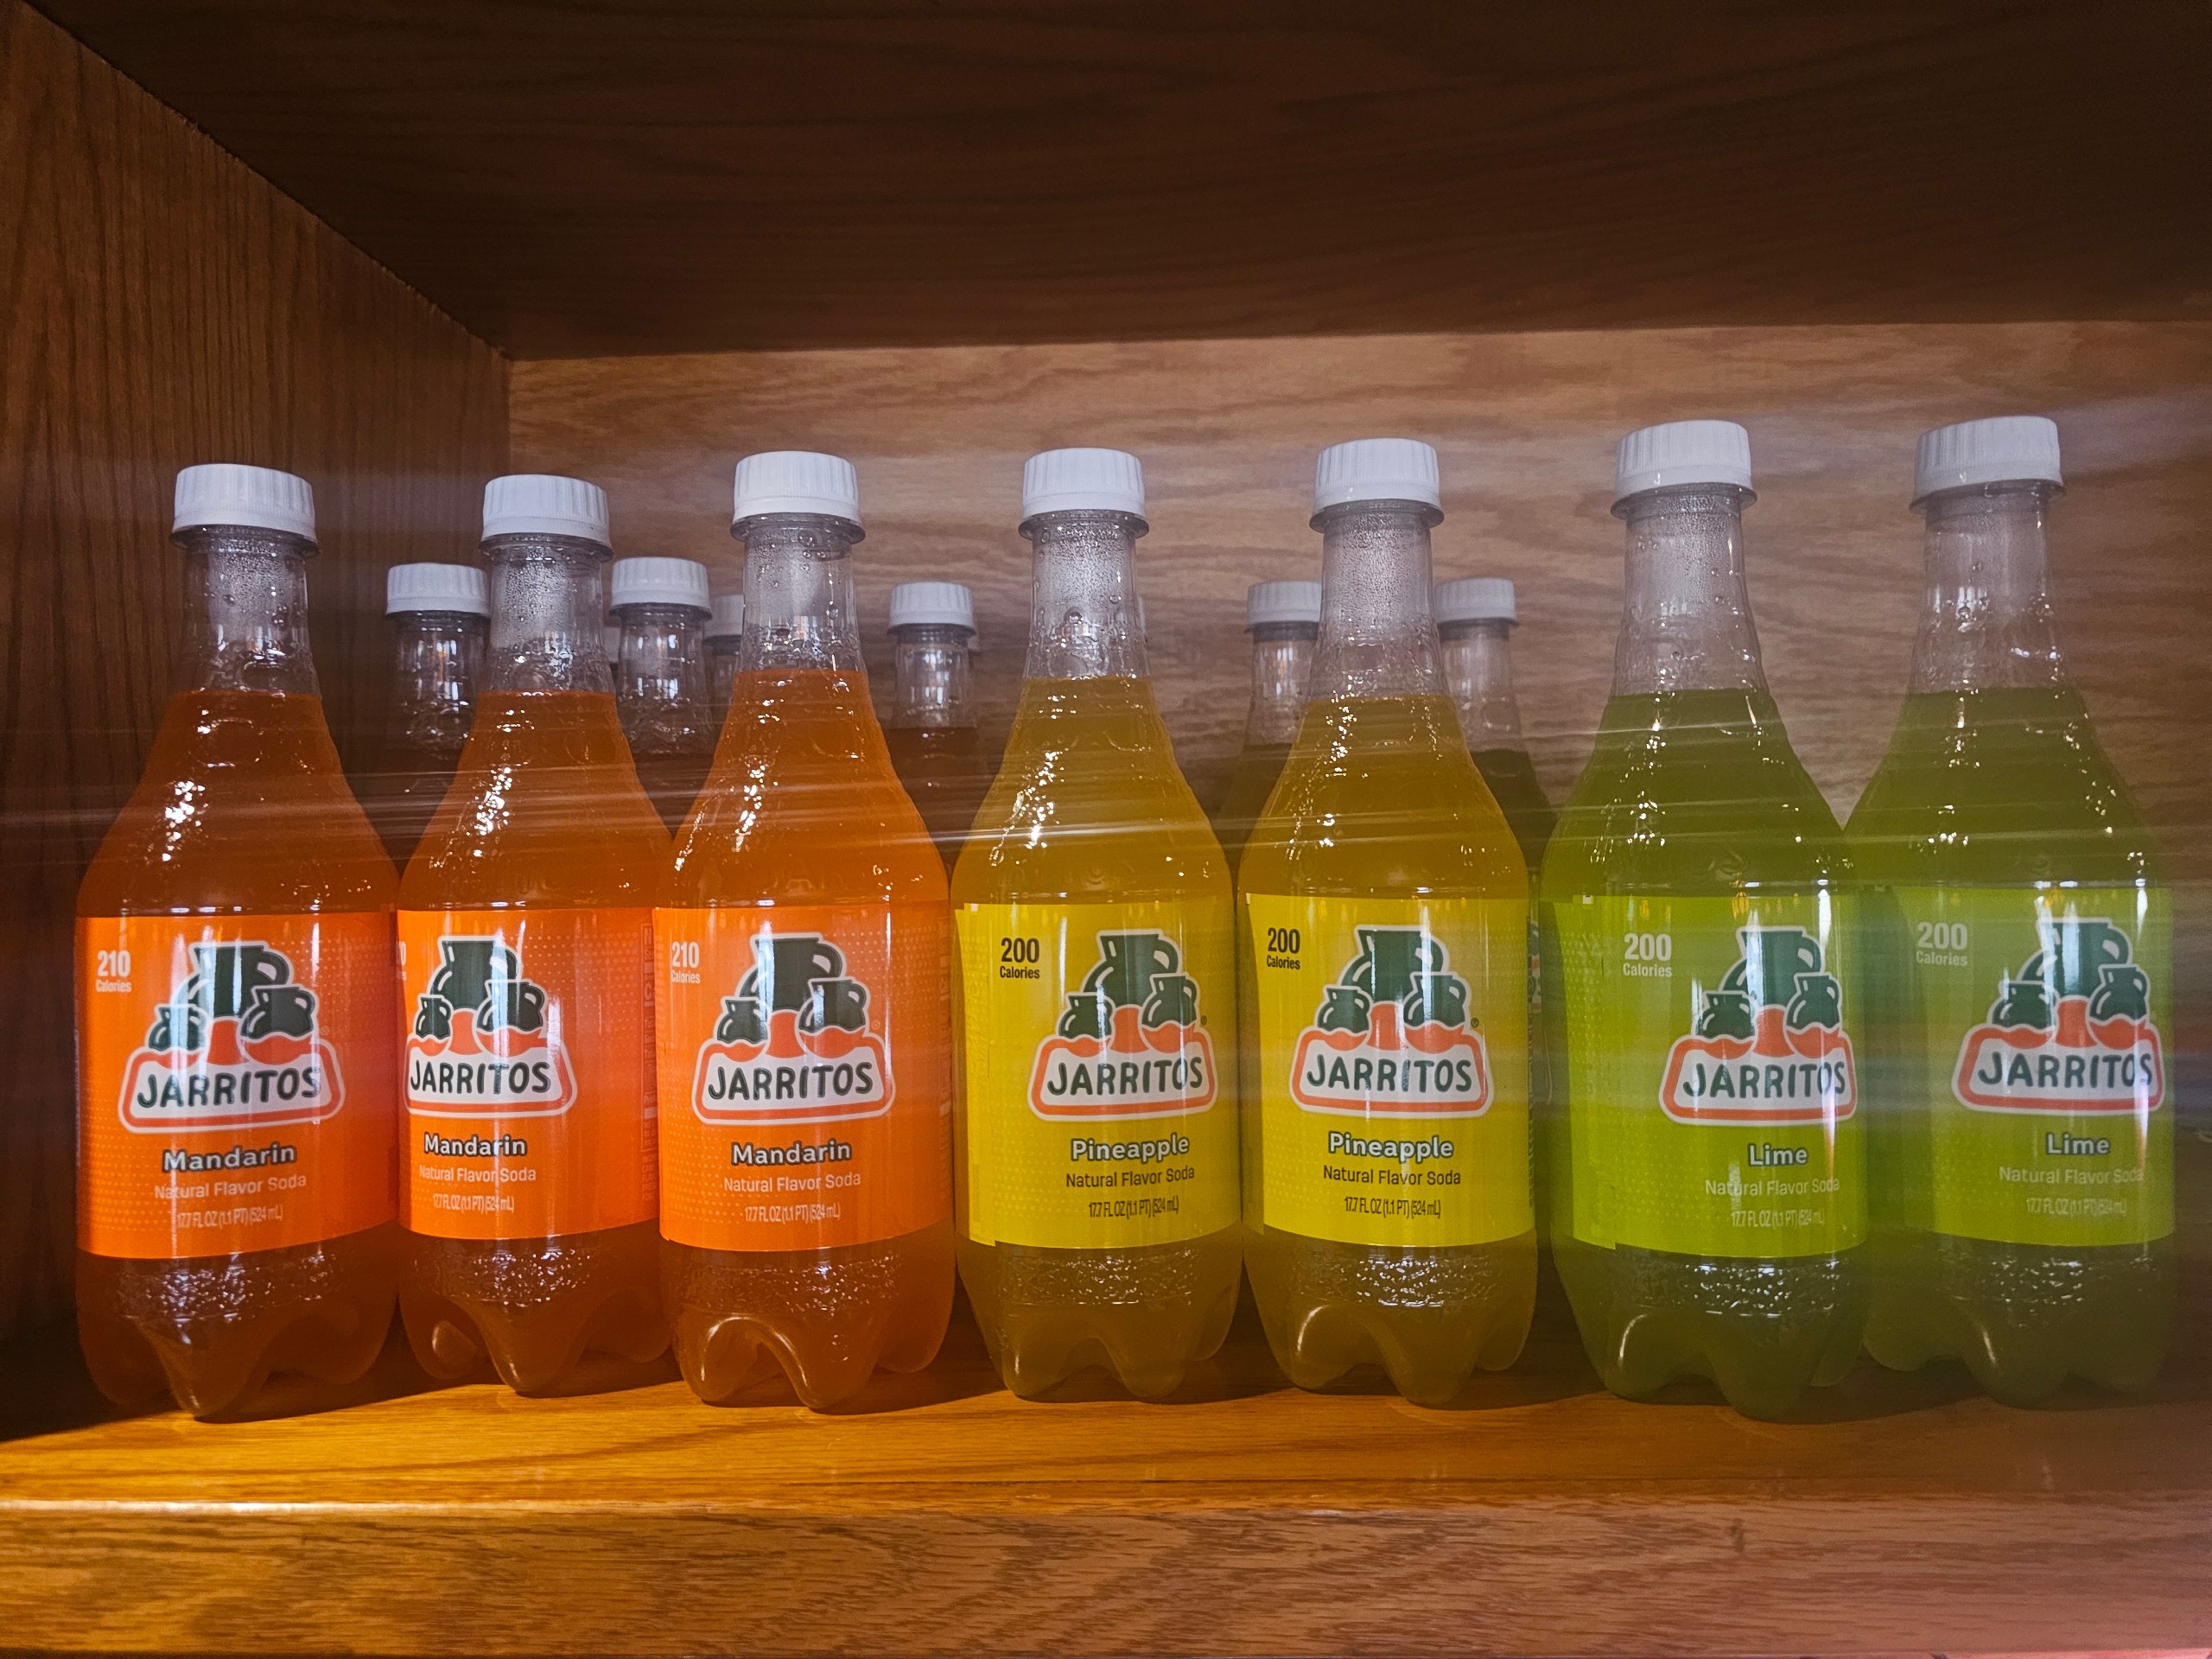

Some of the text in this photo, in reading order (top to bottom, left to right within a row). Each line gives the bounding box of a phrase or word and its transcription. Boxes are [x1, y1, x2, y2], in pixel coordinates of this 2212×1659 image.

[1267, 927, 1300, 954] 200
[1624, 933, 1672, 961] 200
[1917, 921, 1967, 950] 200
[671, 941, 700, 969] 210
[1001, 938, 1039, 963] 200
[1266, 955, 1300, 970] Calories
[1916, 951, 1967, 967] Calories
[98, 950, 130, 977] 210
[999, 964, 1040, 980] Calories
[1623, 963, 1673, 977] Calories
[95, 980, 131, 993] Calories
[671, 970, 701, 985] Calories
[410, 1061, 550, 1095] JARRITOS
[708, 1061, 874, 1101] JARRITOS
[1046, 1056, 1203, 1096] JARRITOS
[1306, 1054, 1472, 1092] JARRITOS
[1682, 1061, 1846, 1098] JARRITOS
[1978, 1052, 2152, 1089] JARRITOS
[137, 1066, 321, 1109] JARRITOS
[424, 1131, 527, 1158] Mandarin
[731, 1137, 852, 1166] Mandarin
[1071, 1131, 1190, 1164] Pineapple
[1328, 1130, 1454, 1164] Pineapple
[1748, 1142, 1808, 1166] Lime
[2046, 1132, 2111, 1155] Lime
[162, 1141, 296, 1173] Mandarin
[419, 1165, 537, 1183] Natural Flavor Soda
[724, 1172, 861, 1192] Natural Flavor Soda
[1066, 1165, 1195, 1187] Natural Flavor Soda
[1323, 1165, 1461, 1185] Natural Flavor Soda
[1999, 1166, 2144, 1185] Natural Flavor Soda
[155, 1174, 307, 1199] Natural Flavor Soda
[1705, 1177, 1840, 1196] Natural Flavor Soda
[193, 1211, 204, 1228] FL
[205, 1211, 216, 1227] OZ
[759, 1206, 769, 1222] FL
[769, 1205, 781, 1222] OZ
[795, 1204, 809, 1224] PT)
[1103, 1201, 1113, 1217] FL
[1114, 1201, 1125, 1217] OZ
[1126, 1200, 1137, 1219] (1.1
[1139, 1198, 1151, 1218] PT)
[1359, 1198, 1369, 1214] FL
[1370, 1198, 1382, 1214] OZ
[1382, 1199, 1395, 1218] (1.1
[1397, 1199, 1410, 1219] PT)
[1411, 1199, 1426, 1219] (524
[1427, 1199, 1441, 1219] mL)
[1748, 1211, 1758, 1227] FL
[1759, 1210, 1770, 1226] OZ
